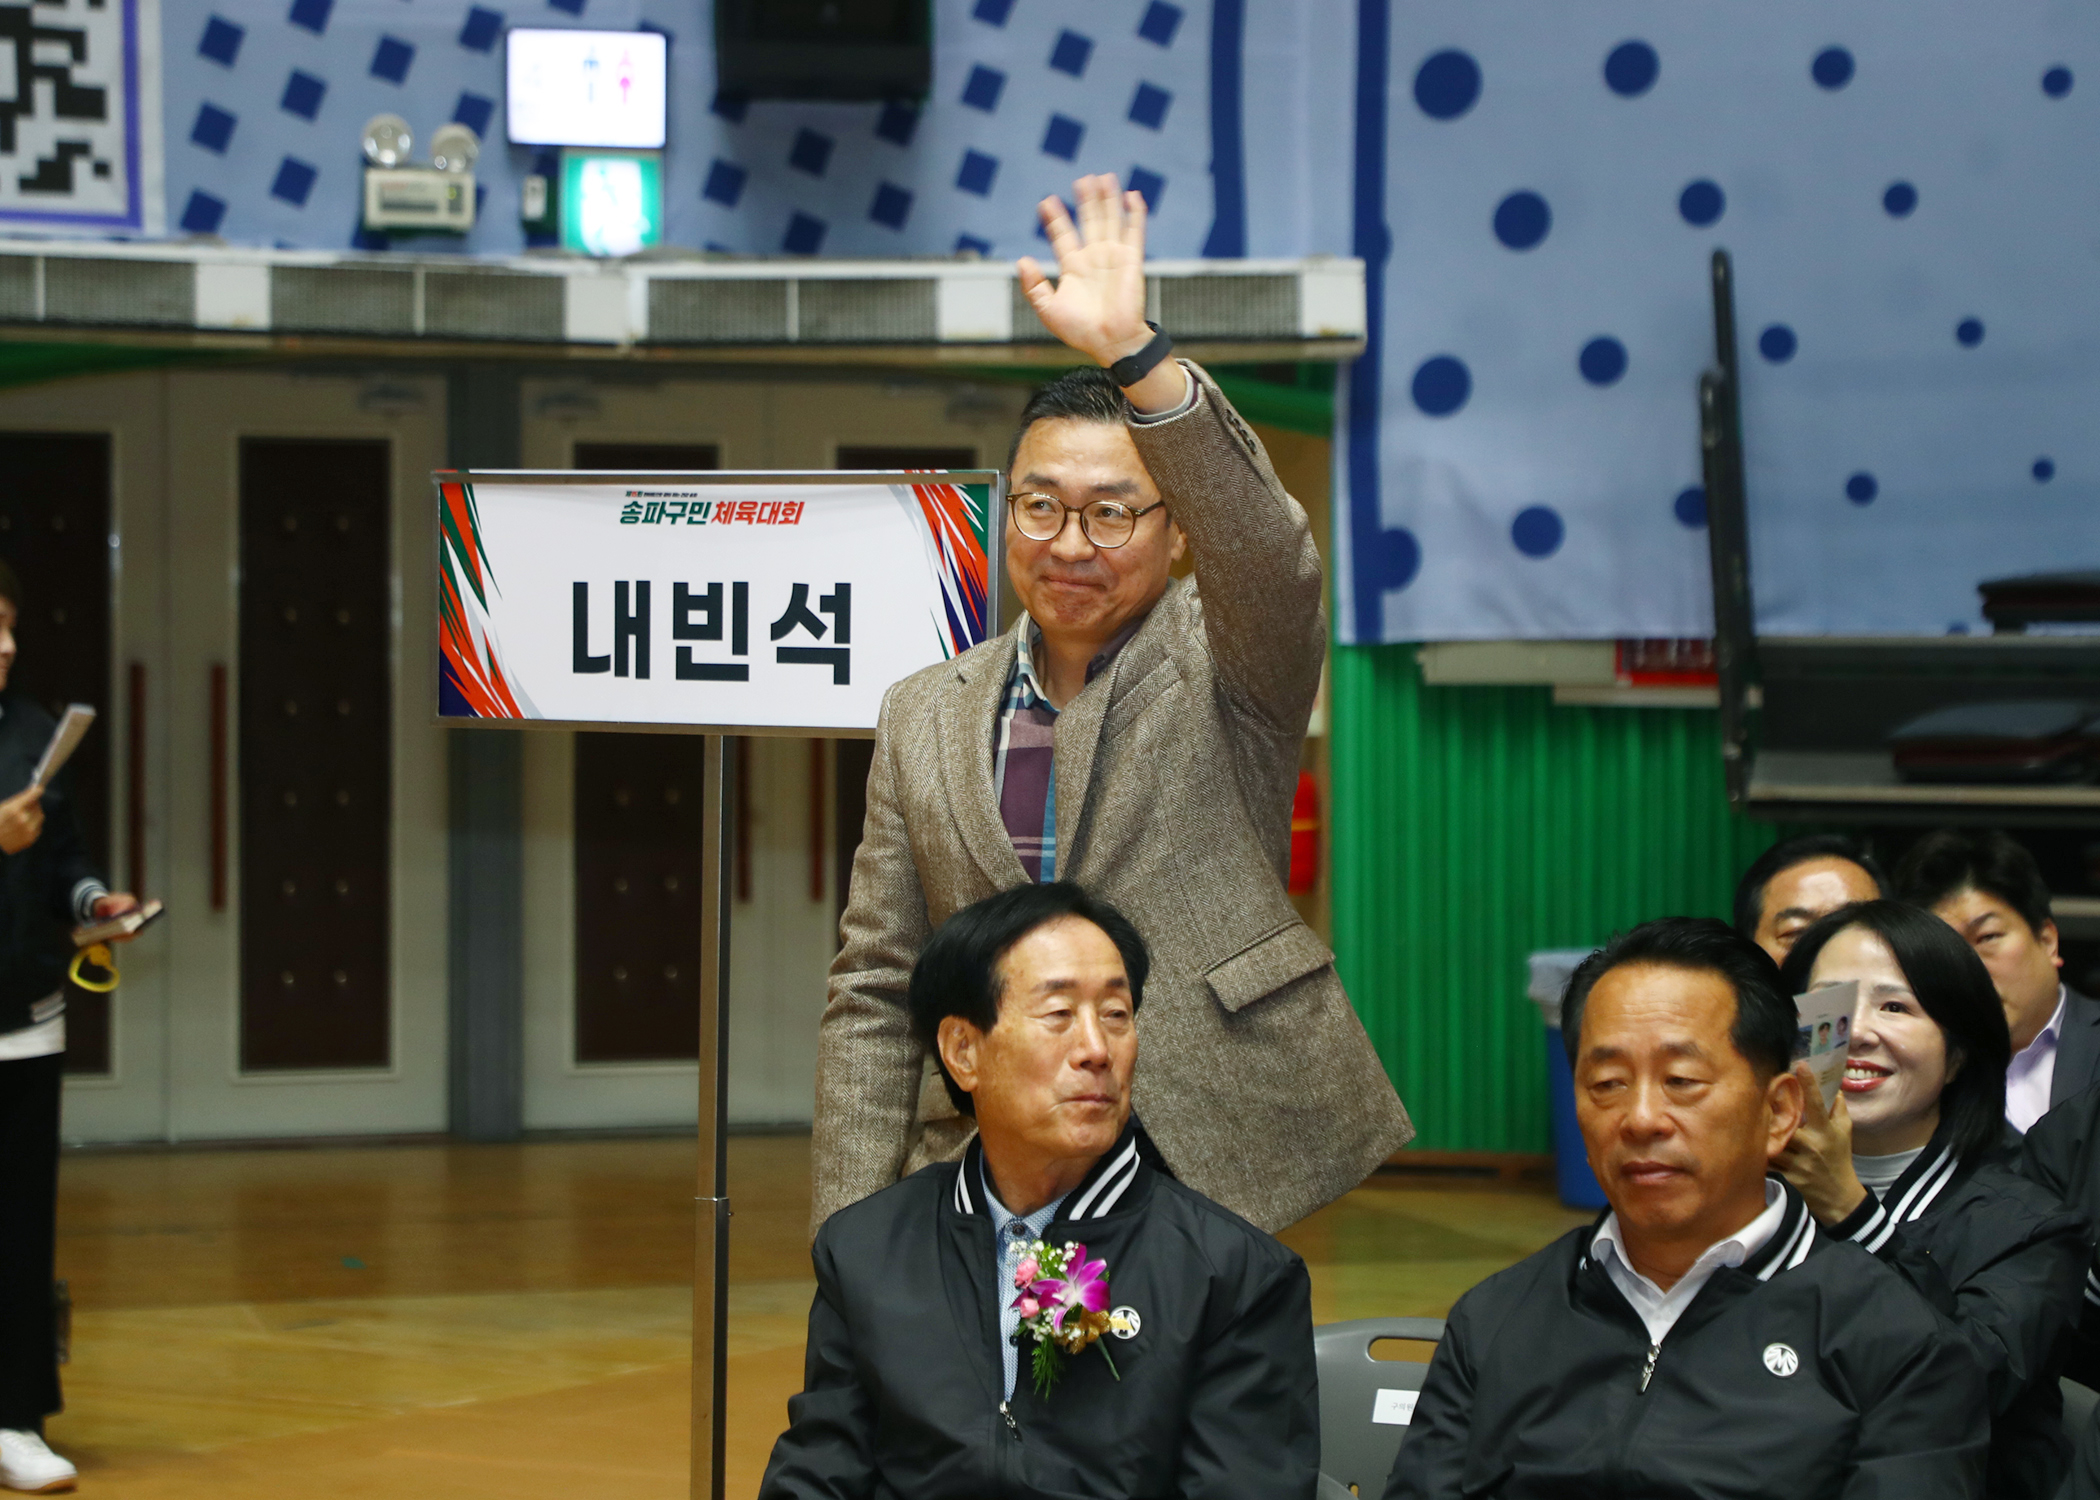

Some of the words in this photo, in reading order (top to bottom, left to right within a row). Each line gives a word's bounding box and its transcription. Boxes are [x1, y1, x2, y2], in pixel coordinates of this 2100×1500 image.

[620, 500, 712, 525] 송파구민
[711, 501, 805, 525] 체육대회
[573, 580, 851, 685] 내빈석
